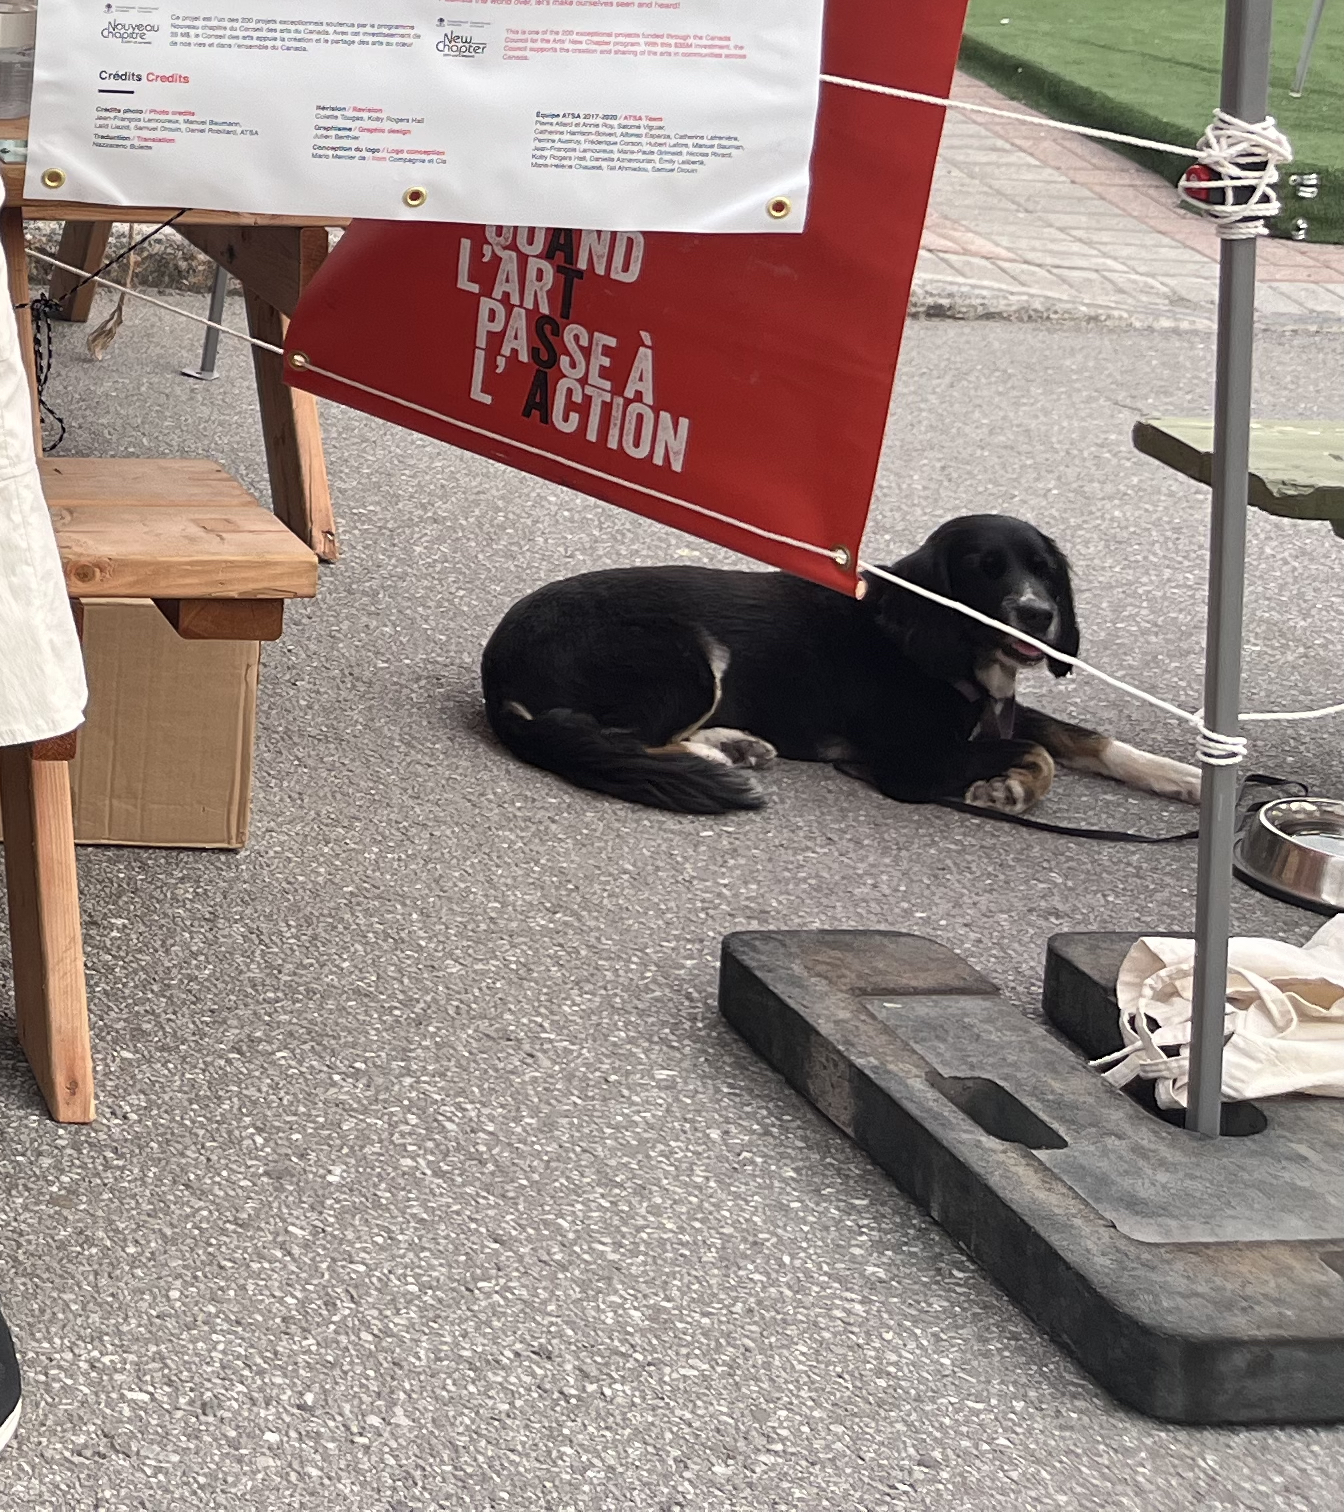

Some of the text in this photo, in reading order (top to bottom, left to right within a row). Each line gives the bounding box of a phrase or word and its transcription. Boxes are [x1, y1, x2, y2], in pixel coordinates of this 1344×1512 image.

[576, 0, 613, 8] ourselves
[637, 1, 653, 9] and
[108, 19, 159, 33] Nouveau
[99, 70, 190, 84] Crédits Credits
[485, 224, 645, 284] QUAND
[457, 238, 584, 320] L'ART
[476, 296, 654, 406] PASSE À
